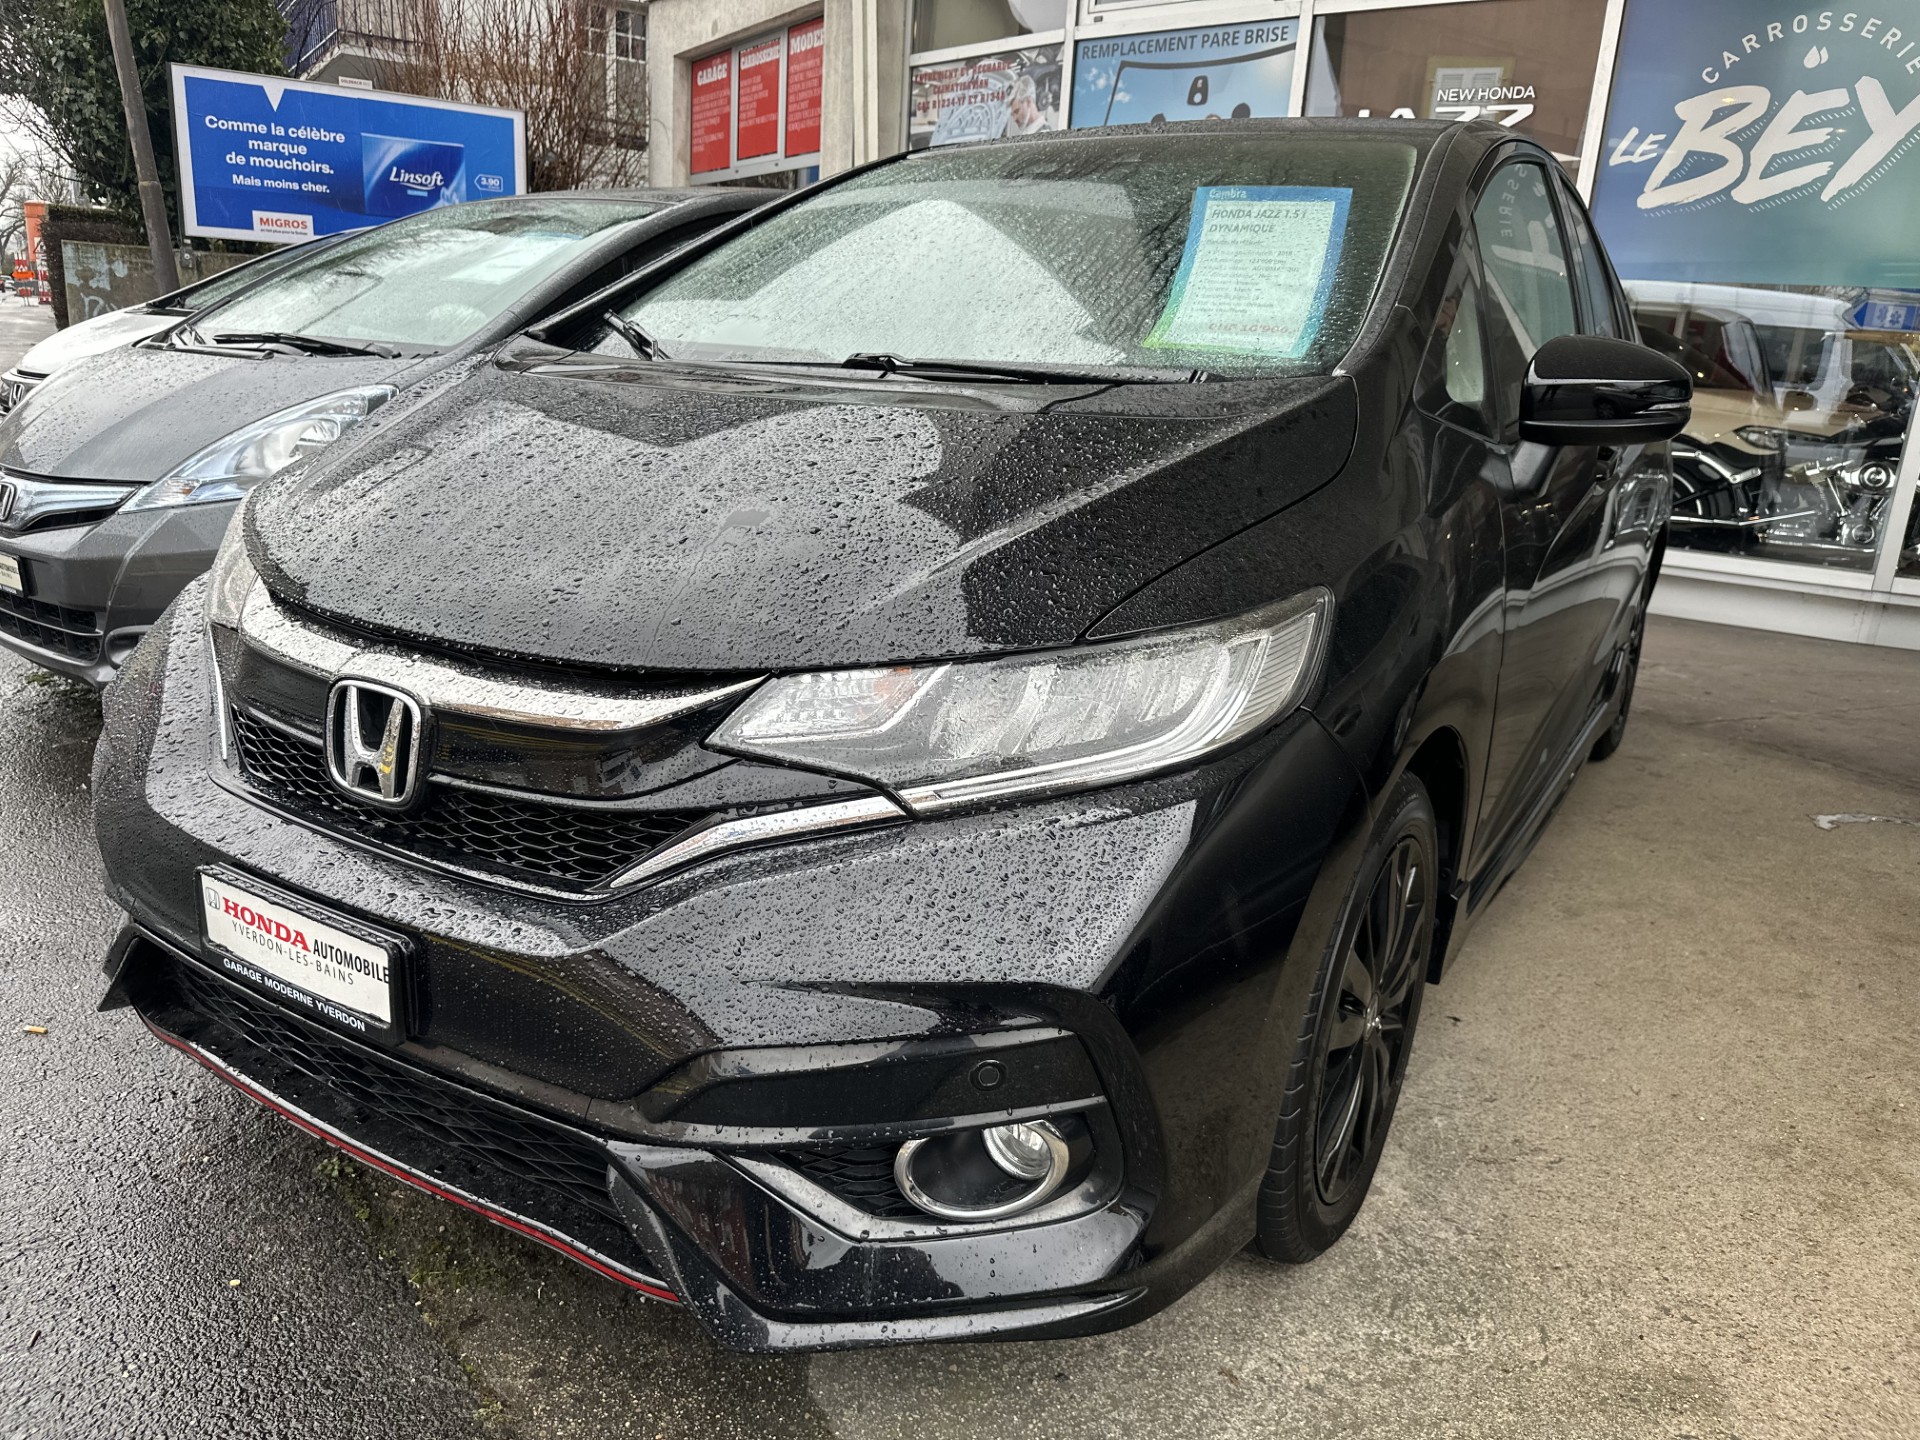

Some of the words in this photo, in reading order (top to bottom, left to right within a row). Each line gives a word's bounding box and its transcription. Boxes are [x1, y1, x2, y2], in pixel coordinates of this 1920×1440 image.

[1082, 35, 1198, 60] REMPLACEMENT
[1200, 30, 1241, 49] PARE
[1244, 25, 1289, 45] BRISE
[1701, 11, 1920, 83] CARROSSERIE
[697, 62, 728, 86] GARAGE
[1437, 88, 1475, 102] NEW
[1477, 85, 1536, 100] HONDA
[205, 115, 267, 134] Comme
[271, 122, 285, 136] la
[288, 125, 346, 143] célèbre
[248, 139, 307, 156] marque
[1608, 126, 1667, 166] LE
[1636, 75, 1920, 209] BEY
[225, 151, 246, 165] de
[249, 155, 335, 174] mouchoirs.
[232, 173, 261, 186] Mais
[263, 178, 300, 191] moins
[301, 181, 330, 193] cher.
[389, 165, 445, 187] Linsoft
[480, 176, 500, 186] 3.90
[259, 217, 308, 230] MIGROS
[1212, 209, 1252, 219] HONDA
[1254, 209, 1281, 219] JAZZ
[1284, 209, 1301, 219] 1.5
[1209, 223, 1277, 233] DYNAMIQUE
[222, 897, 312, 953] HONDA
[313, 938, 390, 984] AUTOMOBILE
[232, 920, 354, 986] YVERDON-LES-BAINS
[223, 958, 263, 984] GARAGE
[265, 977, 313, 1007] MODERNE
[315, 1000, 366, 1032] YVERDON
